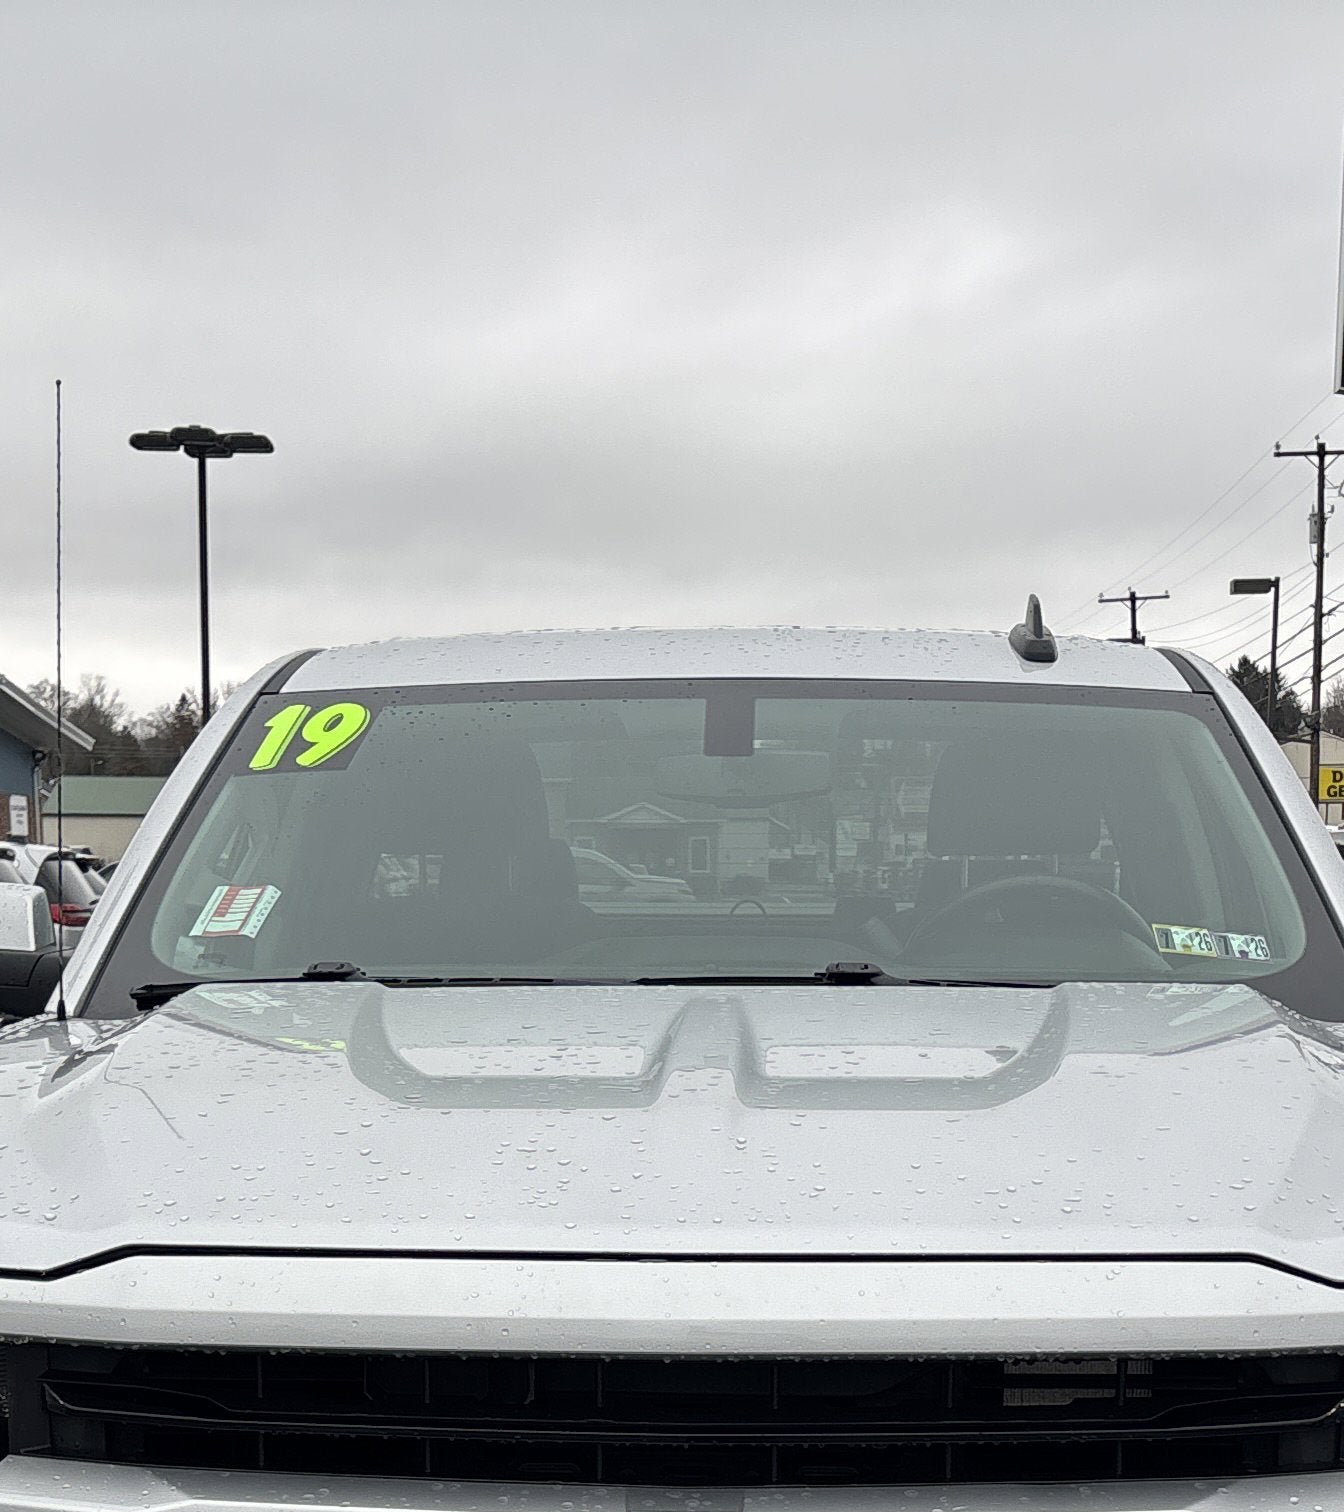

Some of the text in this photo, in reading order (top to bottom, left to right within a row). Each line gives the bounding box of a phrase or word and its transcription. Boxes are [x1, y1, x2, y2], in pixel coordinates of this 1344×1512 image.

[248, 702, 372, 771] 19
[1195, 931, 1213, 952] 26
[1250, 937, 1269, 958] 26
